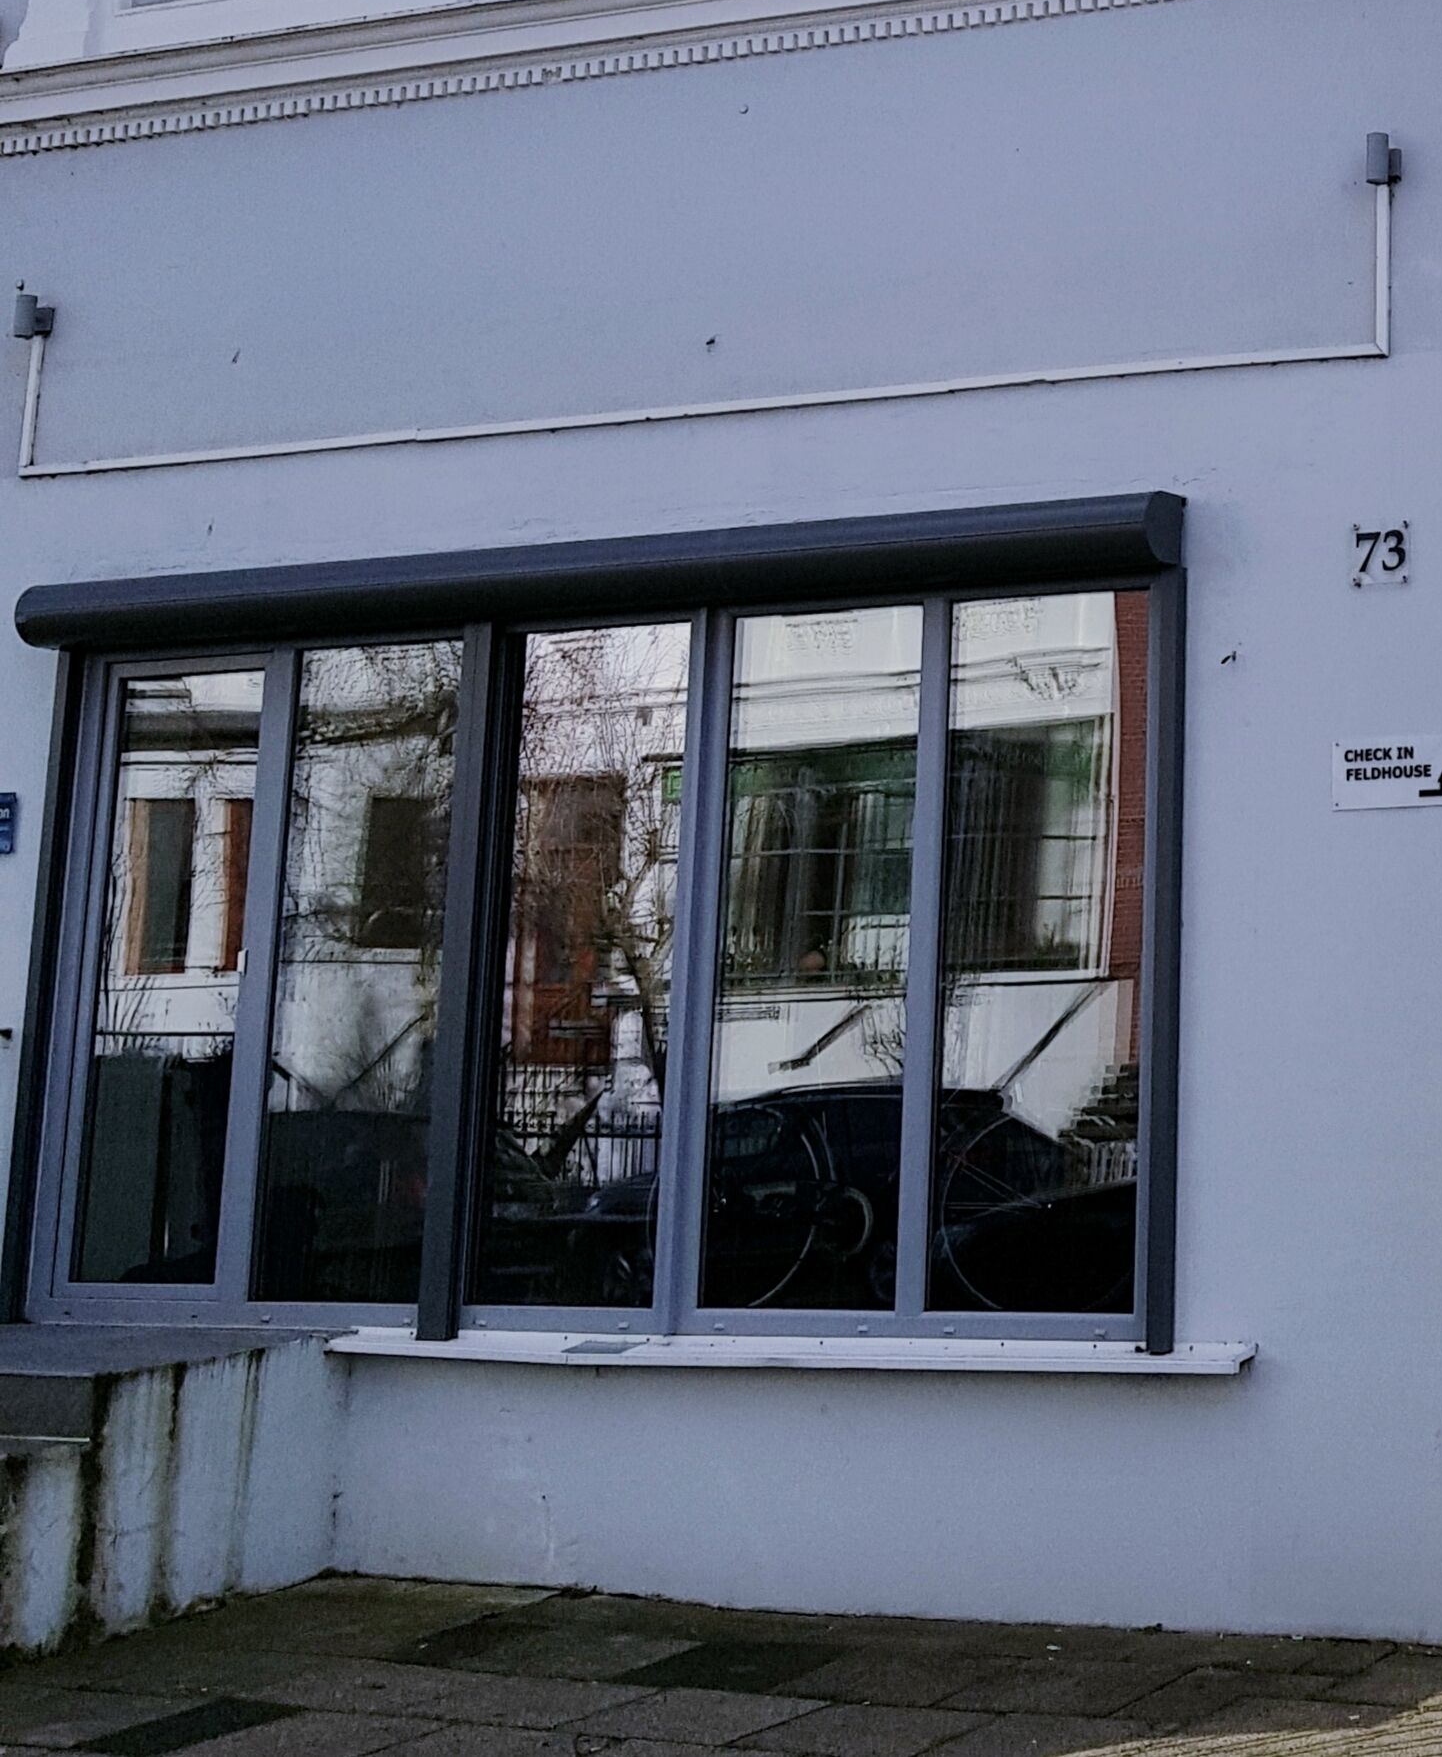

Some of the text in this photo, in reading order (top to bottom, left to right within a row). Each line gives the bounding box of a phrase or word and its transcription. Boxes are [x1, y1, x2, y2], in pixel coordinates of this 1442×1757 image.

[1355, 529, 1406, 573] 73
[1344, 746, 1414, 763] CHECK IN
[1346, 764, 1432, 781] FELDHOUSE
